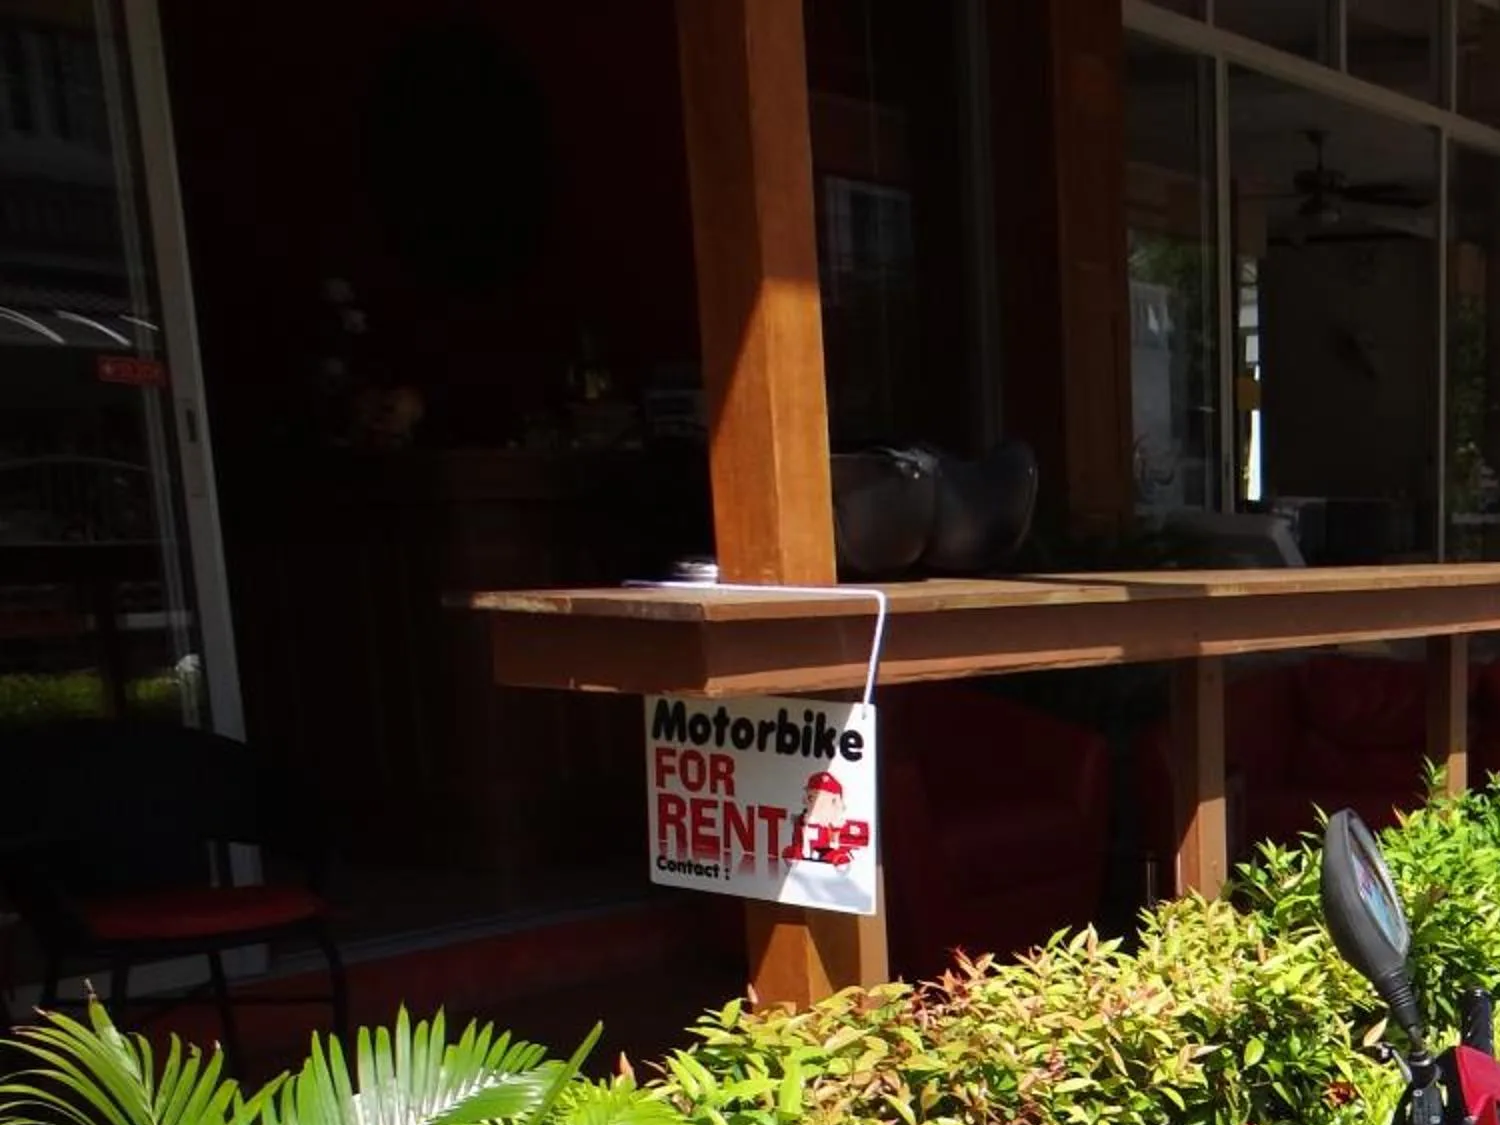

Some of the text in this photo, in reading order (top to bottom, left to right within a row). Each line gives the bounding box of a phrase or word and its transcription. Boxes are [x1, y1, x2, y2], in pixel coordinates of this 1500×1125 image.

[652, 698, 864, 762] Motorbike
[655, 747, 736, 796] FOR
[657, 793, 787, 862] RENT
[656, 855, 719, 879] Contact
